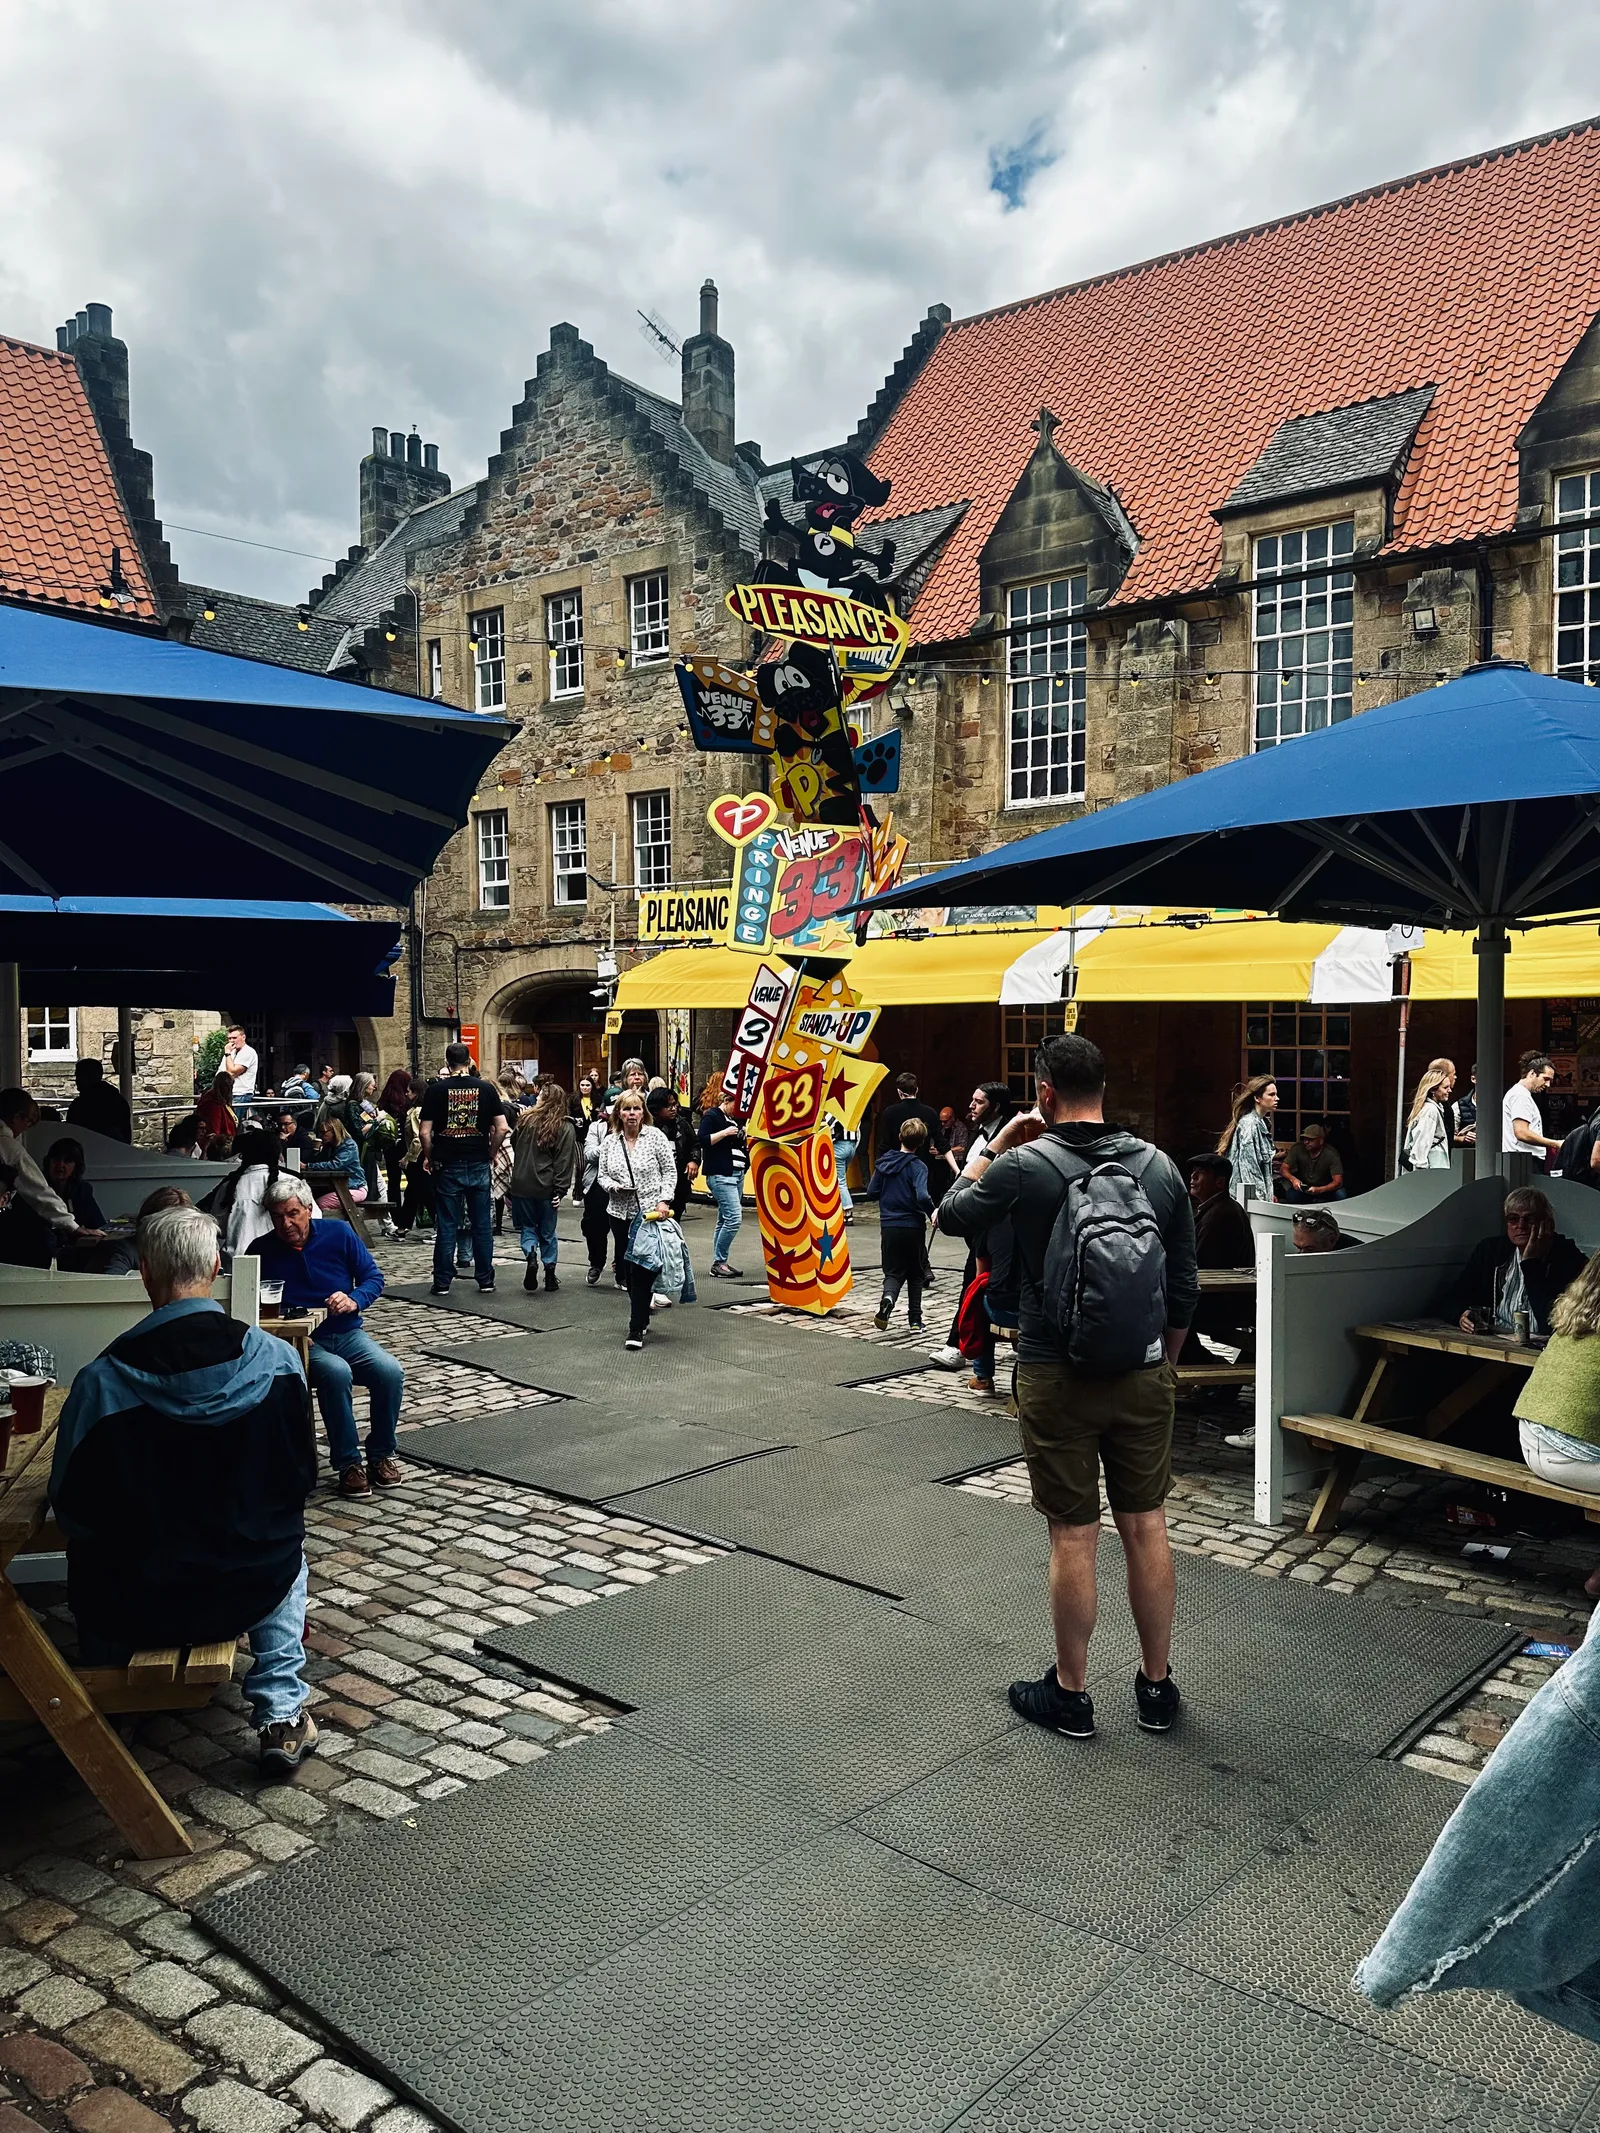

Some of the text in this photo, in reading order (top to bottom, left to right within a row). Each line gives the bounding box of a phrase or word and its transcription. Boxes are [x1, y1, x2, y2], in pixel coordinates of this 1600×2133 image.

[735, 583, 894, 644] PLEASANCE
[698, 691, 753, 713] VENUE
[706, 704, 743, 730] 33
[786, 762, 821, 819] P
[723, 805, 763, 836] P
[775, 828, 835, 861] VENUE
[741, 833, 772, 942] FRINGE
[770, 838, 862, 940] 33
[754, 986, 783, 1003] VENUE
[799, 1011, 872, 1044] STAND UP
[771, 1073, 814, 1127] 33
